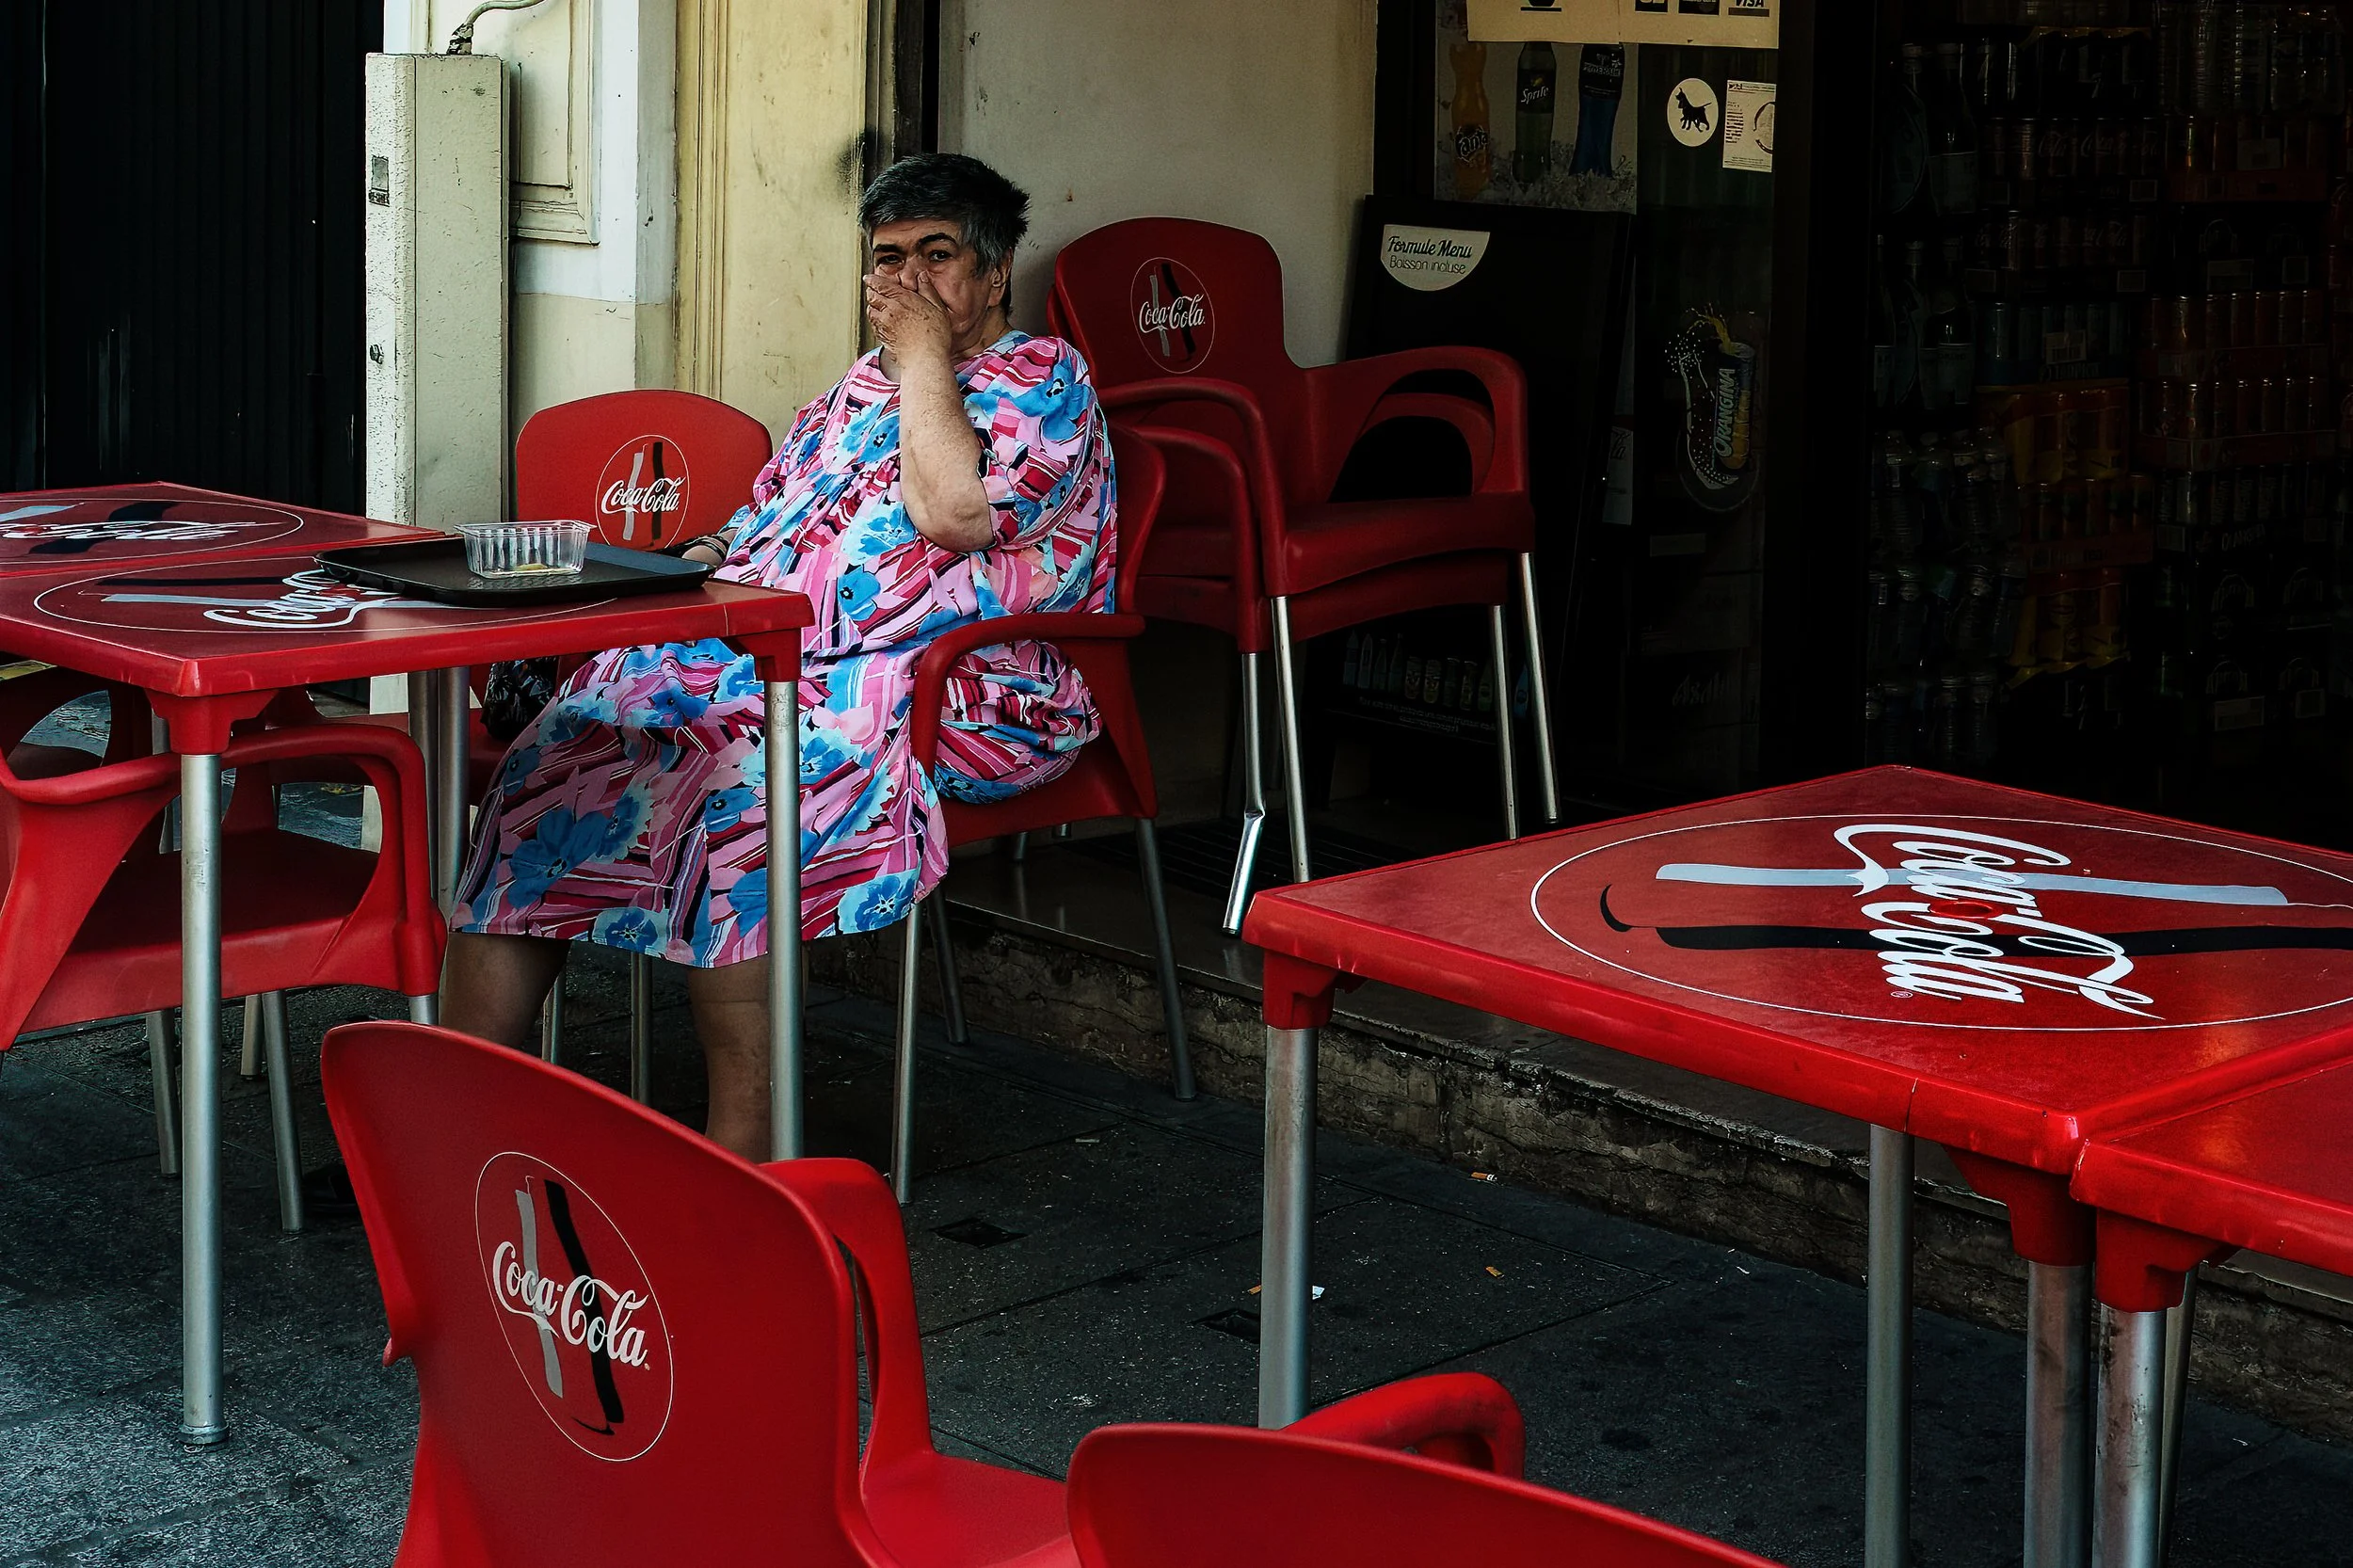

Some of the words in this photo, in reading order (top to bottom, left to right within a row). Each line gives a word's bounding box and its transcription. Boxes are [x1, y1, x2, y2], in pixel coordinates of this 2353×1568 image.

[1387, 235, 1436, 256] Formule
[1437, 239, 1472, 259] Menu
[1389, 255, 1429, 271] Boisson
[1431, 259, 1466, 275] incluse
